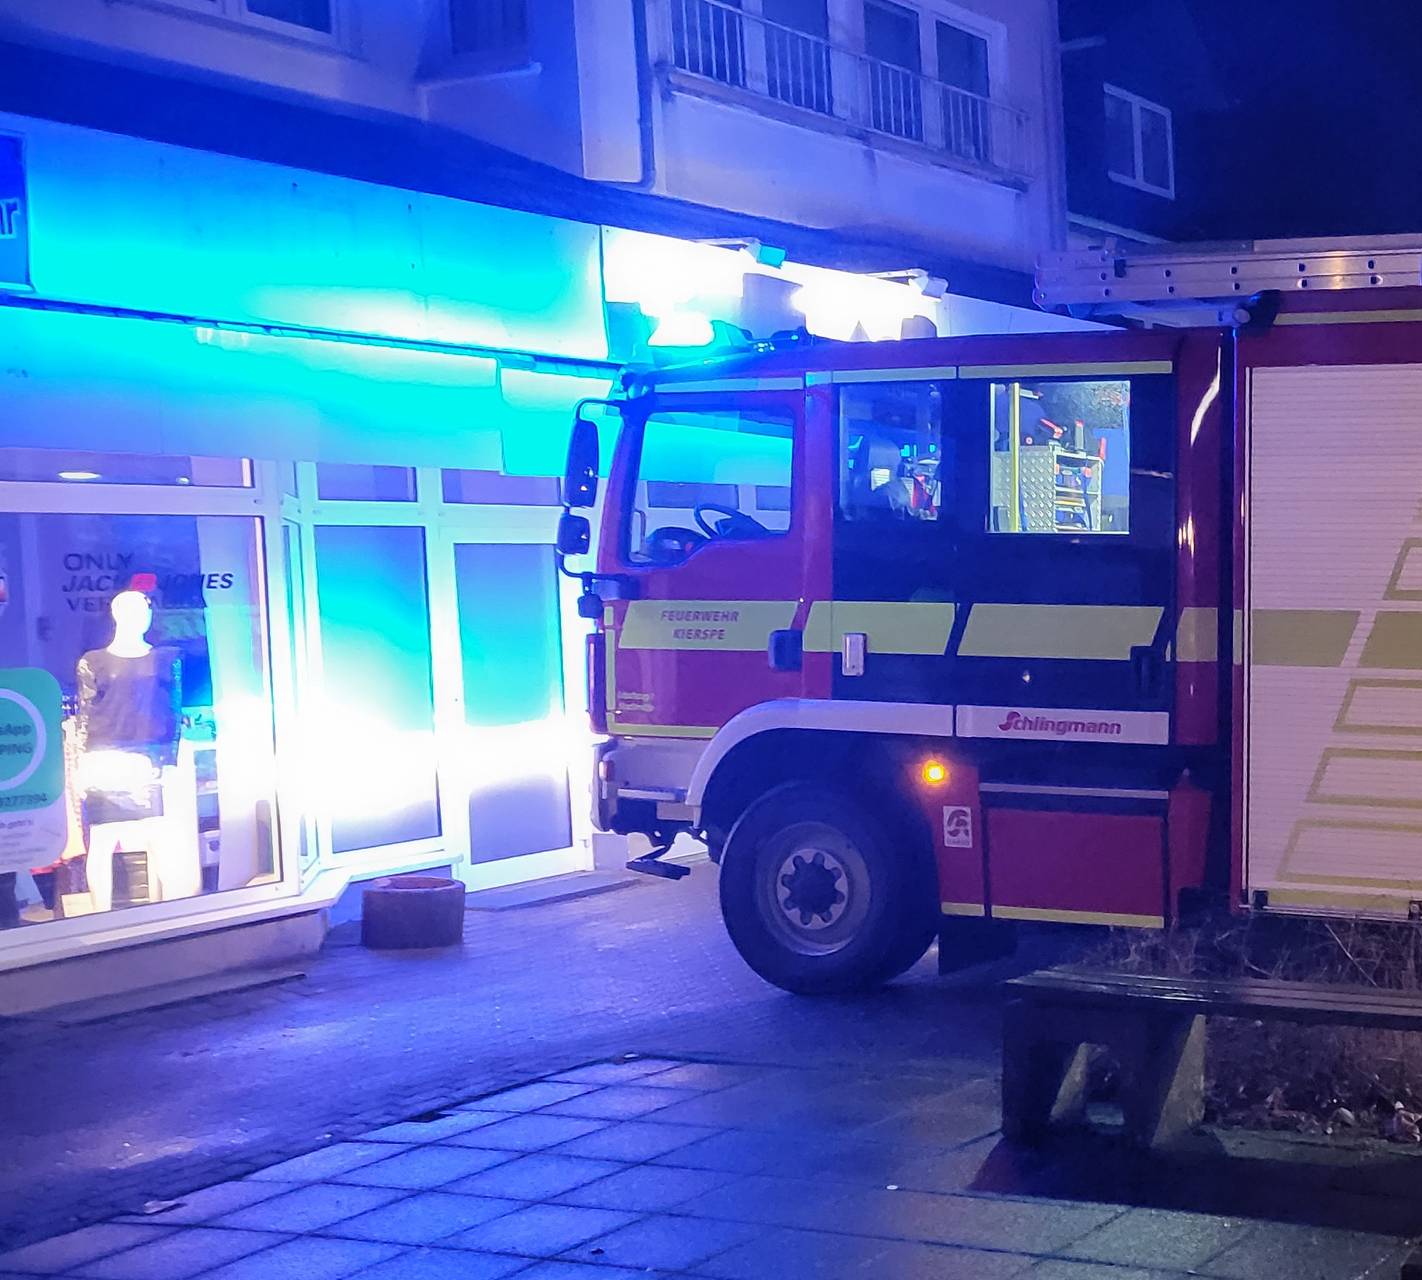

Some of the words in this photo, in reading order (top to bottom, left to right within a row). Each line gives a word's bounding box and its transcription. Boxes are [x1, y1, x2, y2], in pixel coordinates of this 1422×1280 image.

[63, 553, 135, 572] ONLY
[661, 610, 740, 622] FEUERWEHR
[673, 628, 726, 640] KIERSPE
[998, 711, 1122, 735] Schlingmann
